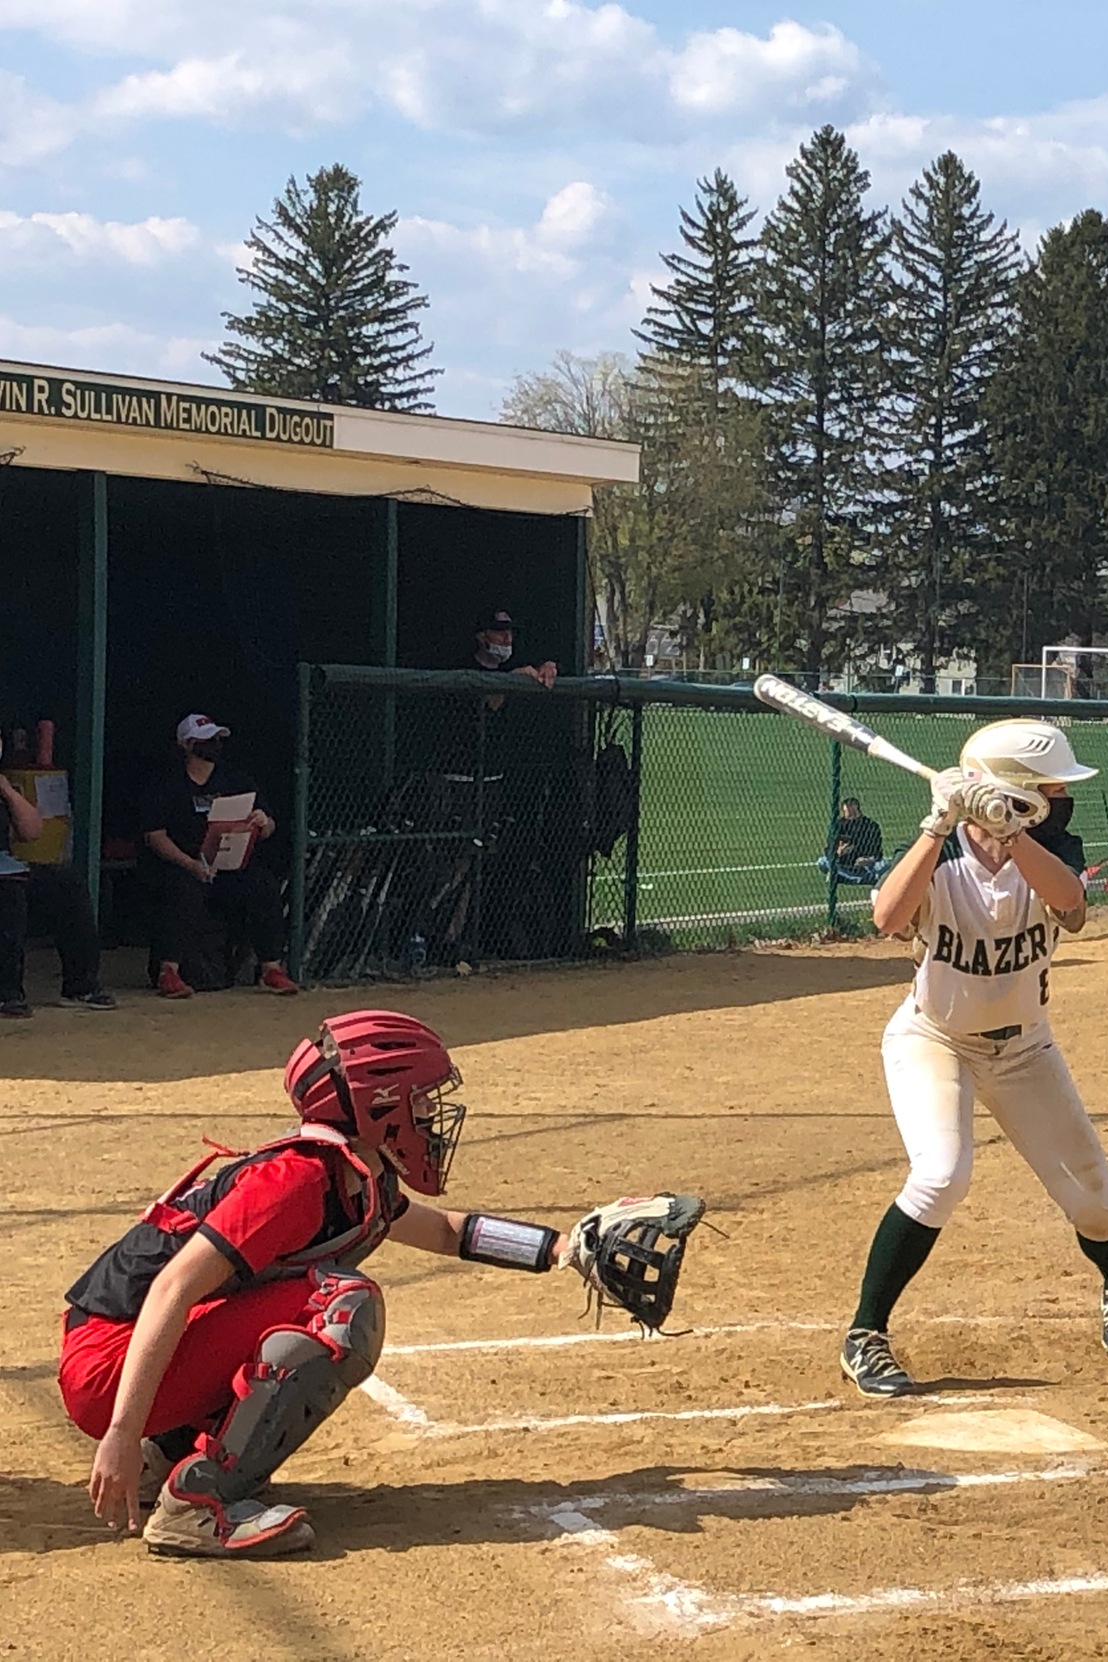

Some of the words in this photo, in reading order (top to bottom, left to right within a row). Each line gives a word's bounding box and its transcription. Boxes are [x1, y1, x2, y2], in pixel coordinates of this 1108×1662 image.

[33, 378, 55, 415] R.
[160, 393, 262, 438] MEMORIAL
[265, 406, 333, 446] DUGOUT
[760, 680, 852, 733] EASTON
